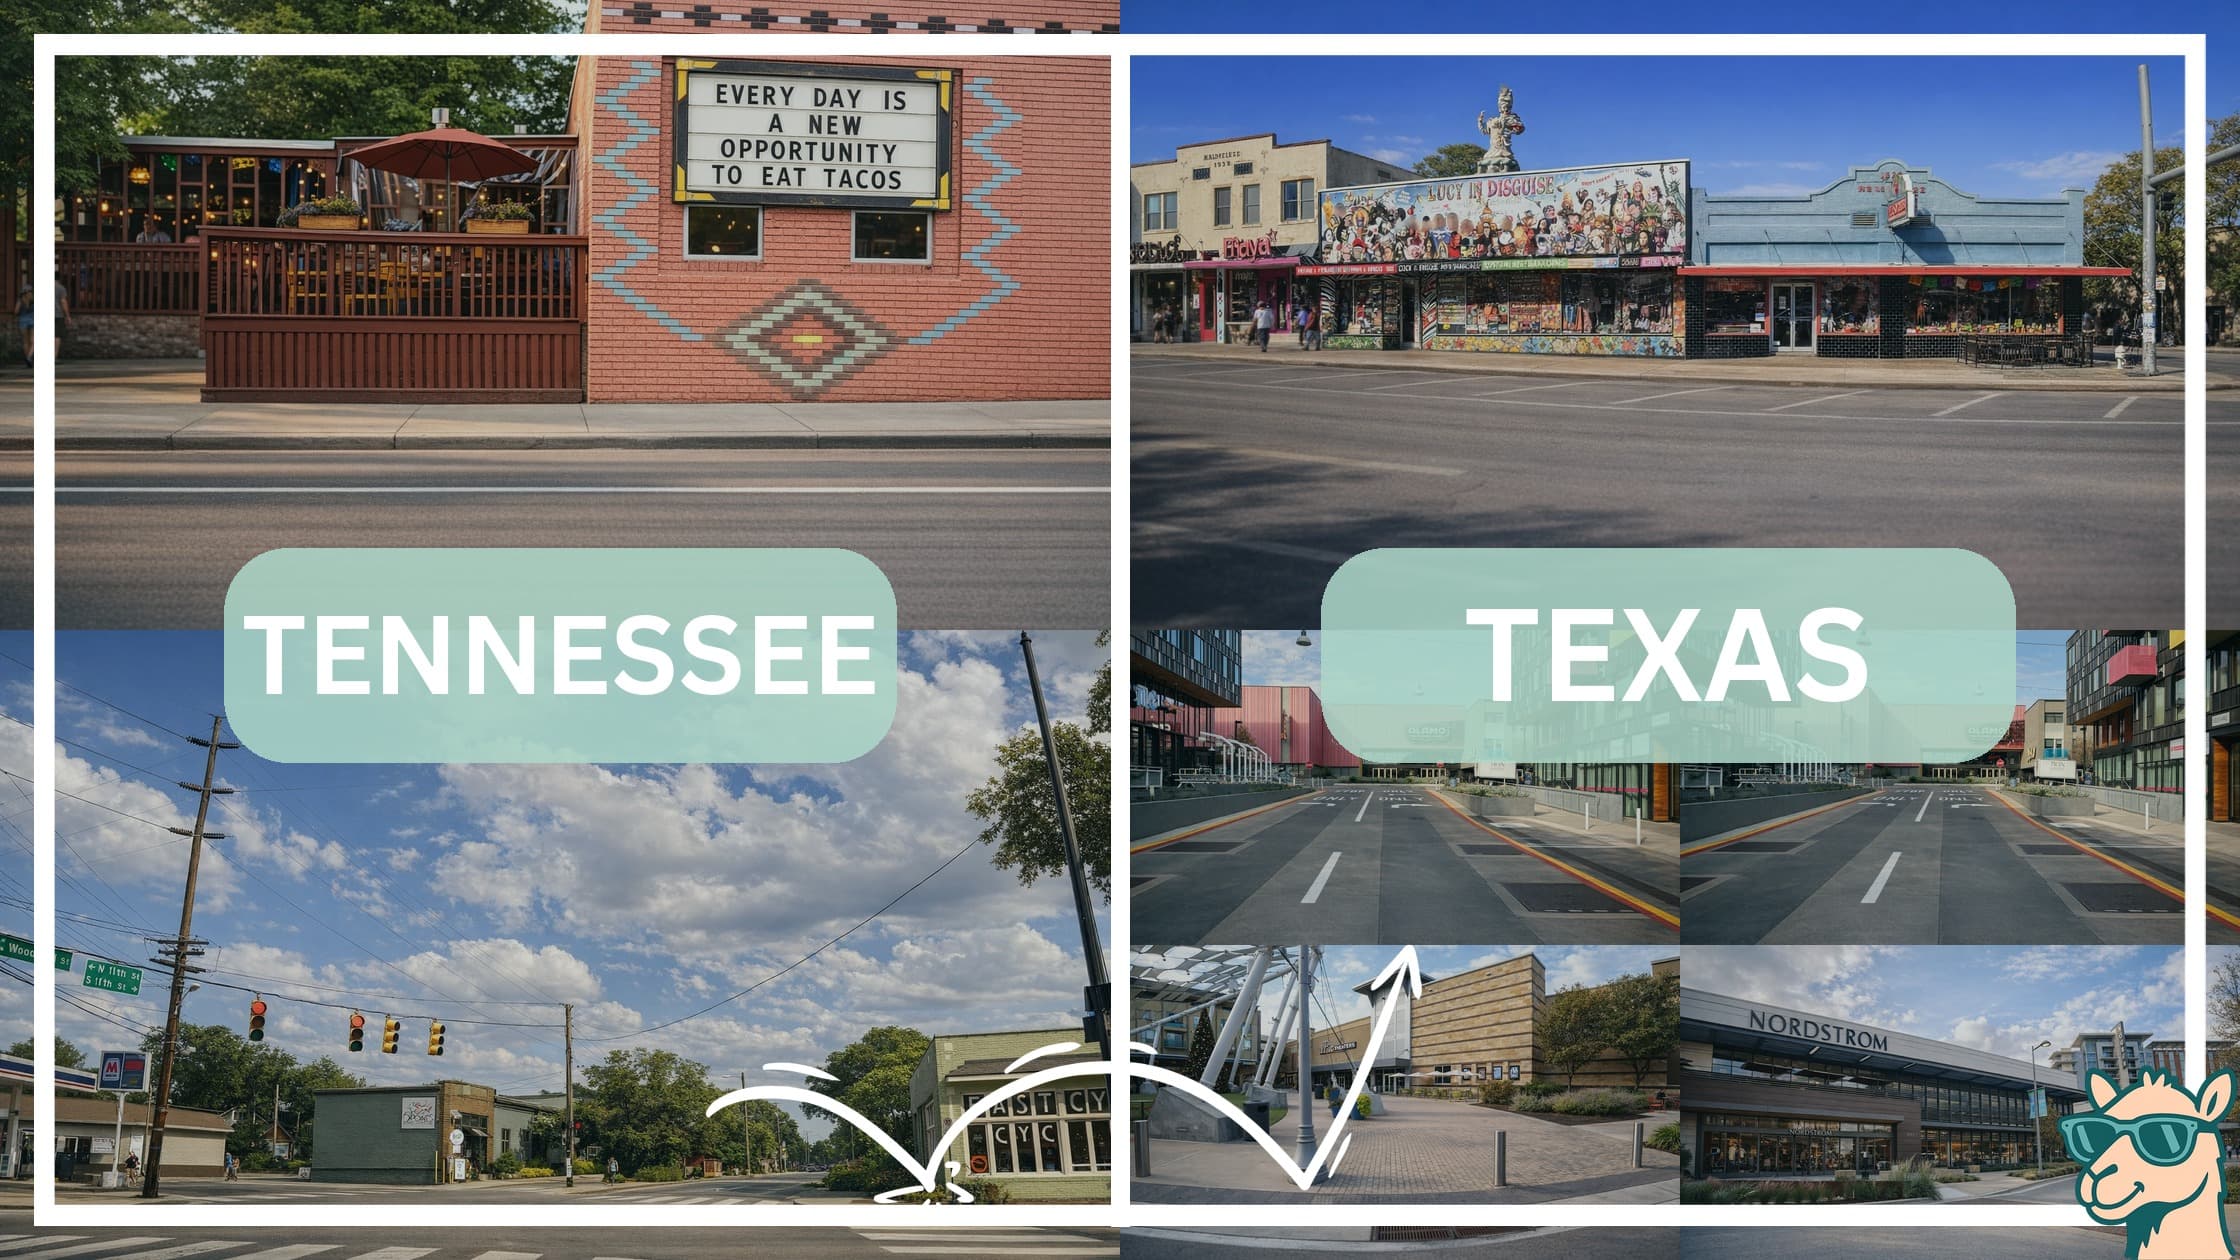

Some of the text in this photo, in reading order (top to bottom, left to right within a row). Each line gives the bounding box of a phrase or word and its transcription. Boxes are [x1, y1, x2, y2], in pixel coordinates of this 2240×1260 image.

[715, 83, 907, 111] EVERY DAY IS
[768, 113, 862, 136] A NEW
[720, 138, 897, 164] OPPORTUNITY
[711, 165, 902, 190] TO EAT TACOS
[1427, 176, 1554, 202] LUCY IN DISGUISE
[85, 975, 92, 984] S
[117, 982, 127, 992] St
[98, 962, 105, 973] N
[131, 971, 141, 981] St
[1749, 1009, 1888, 1052] NORDSTROM
[995, 1125, 1056, 1145] CYC
